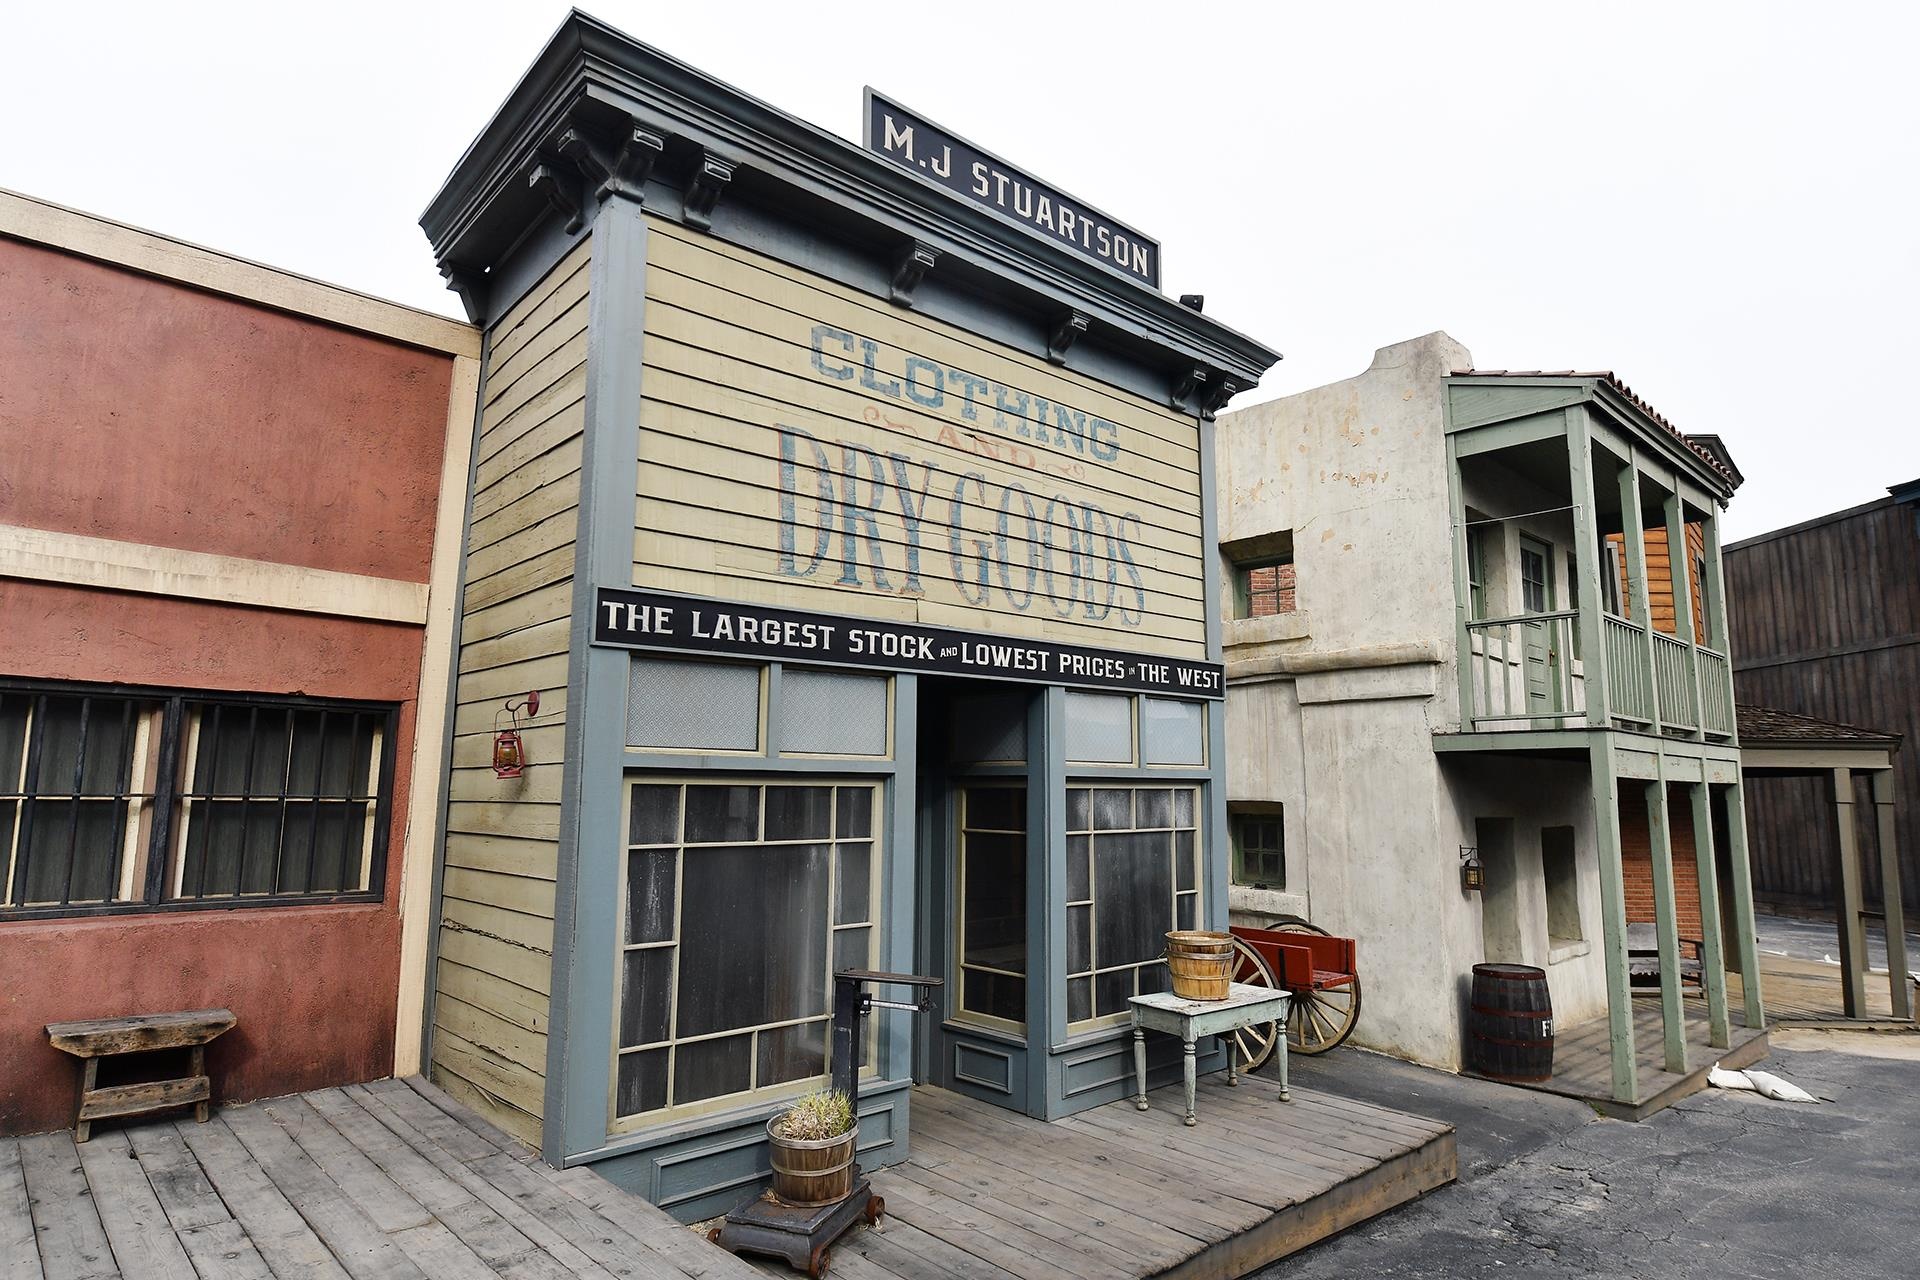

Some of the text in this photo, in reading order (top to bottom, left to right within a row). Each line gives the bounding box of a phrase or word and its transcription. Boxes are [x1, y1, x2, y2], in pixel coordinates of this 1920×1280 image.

[972, 161, 1149, 277] STUARTSON
[811, 325, 1121, 463] CLOTHING
[936, 424, 1036, 471] AND
[773, 423, 1145, 627] DRY GOODS
[602, 600, 1220, 690] THE LARGEST STOCK AND LOWEST PRICES IN THE WEST
